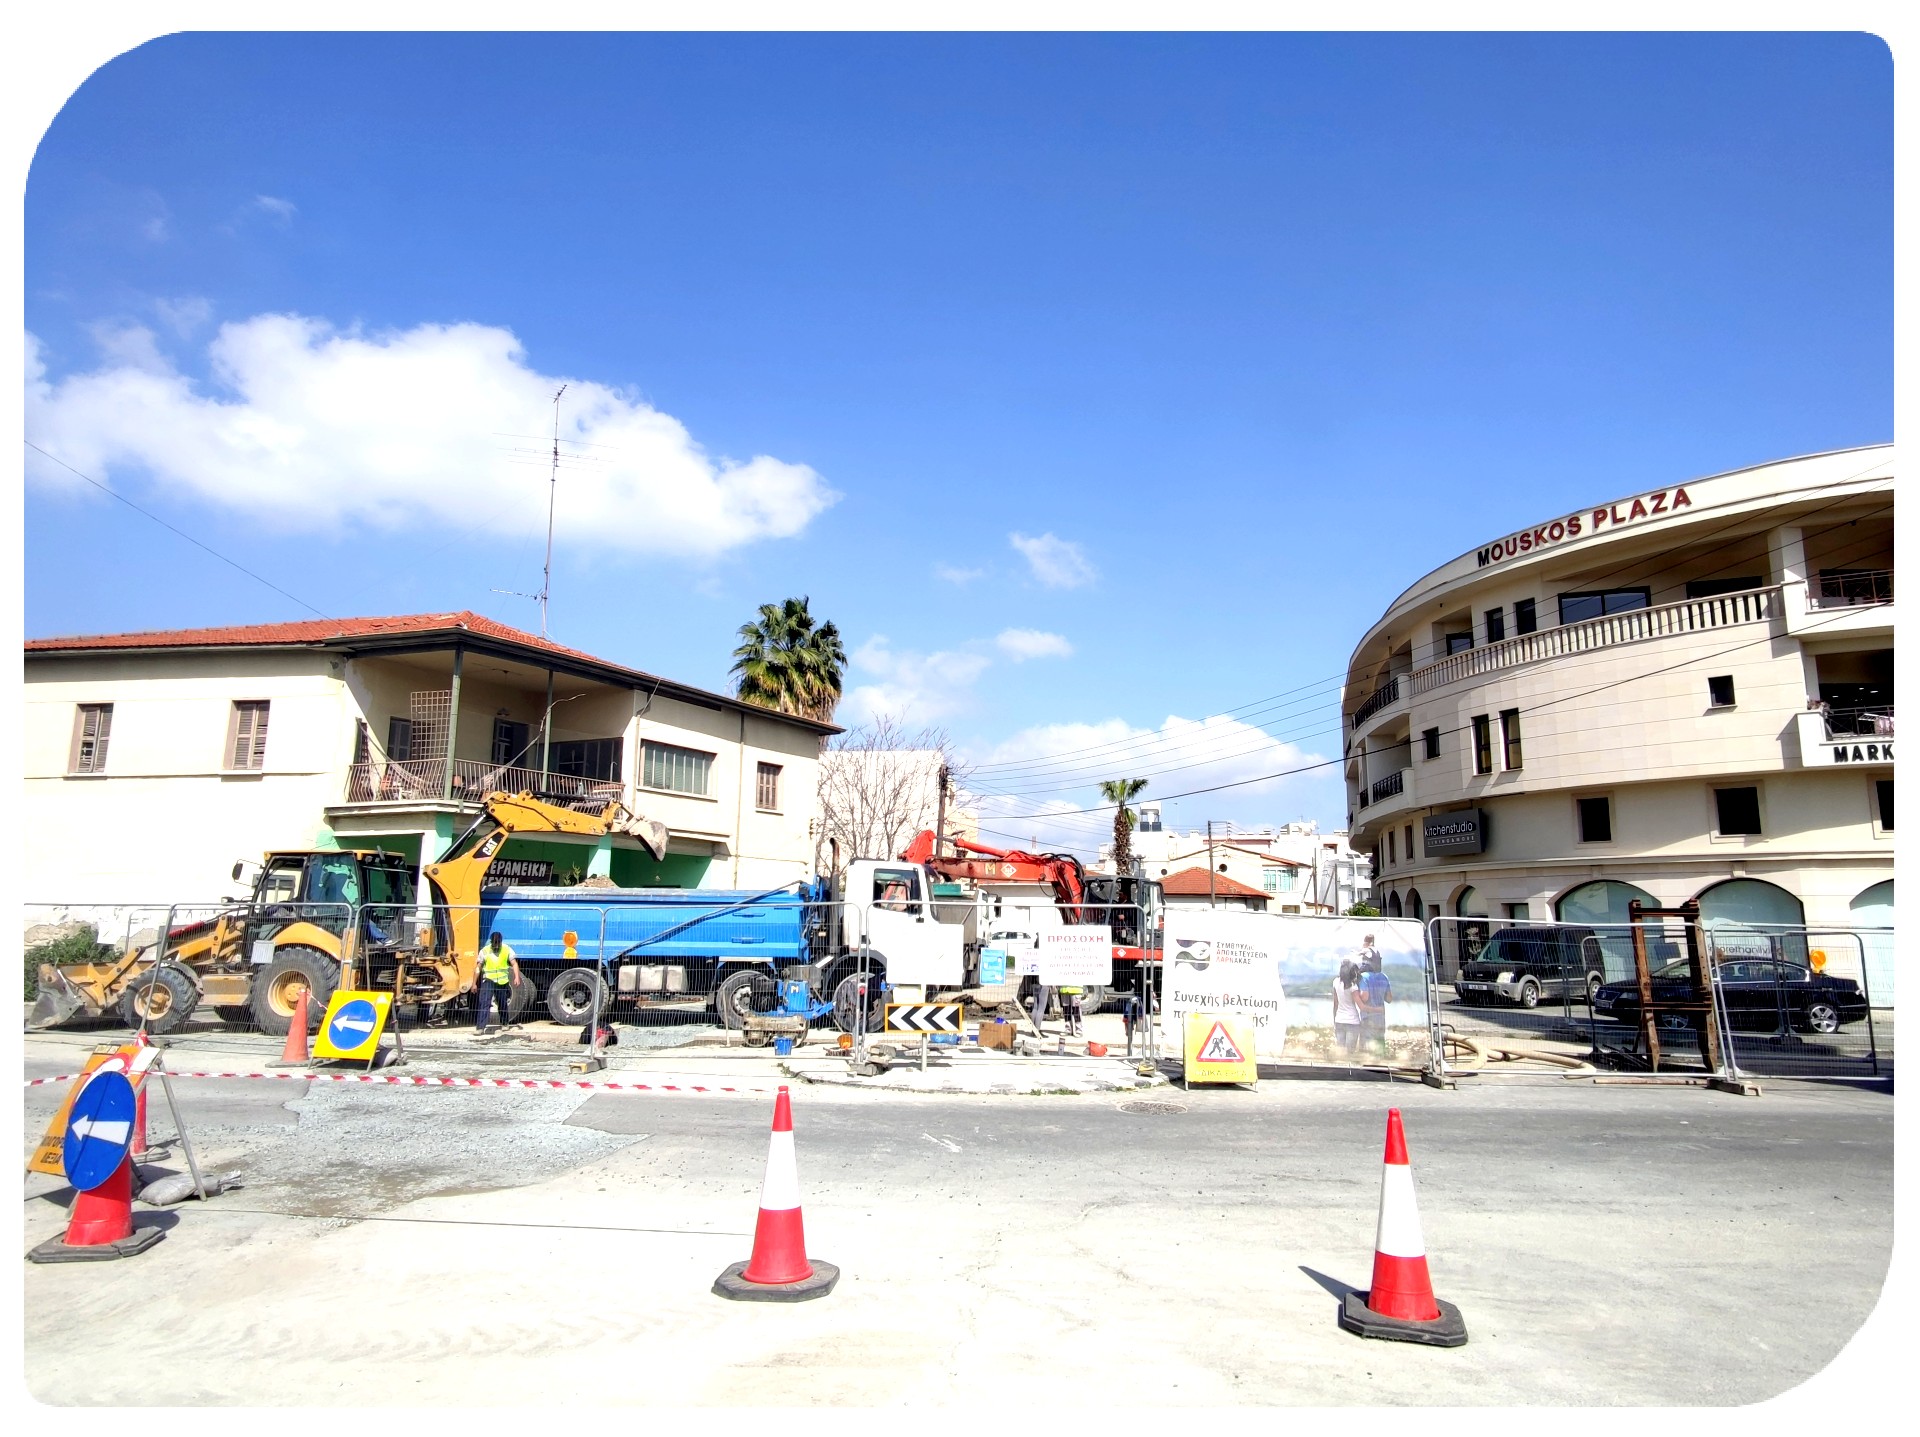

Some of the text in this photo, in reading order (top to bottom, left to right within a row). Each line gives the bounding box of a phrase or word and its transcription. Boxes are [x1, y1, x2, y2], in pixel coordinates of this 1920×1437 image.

[1477, 488, 1693, 568] MOUSKOS PLAZA
[1833, 744, 1894, 763] MARK
[482, 838, 498, 856] CAT
[487, 860, 546, 877] ΕΡΑΜΕΙΚΗ
[1047, 935, 1104, 943] ΠΡΟΣΟΧΗ
[1173, 990, 1278, 1012] Συνεχής βελτίωση
[1252, 1012, 1269, 1028] ής!
